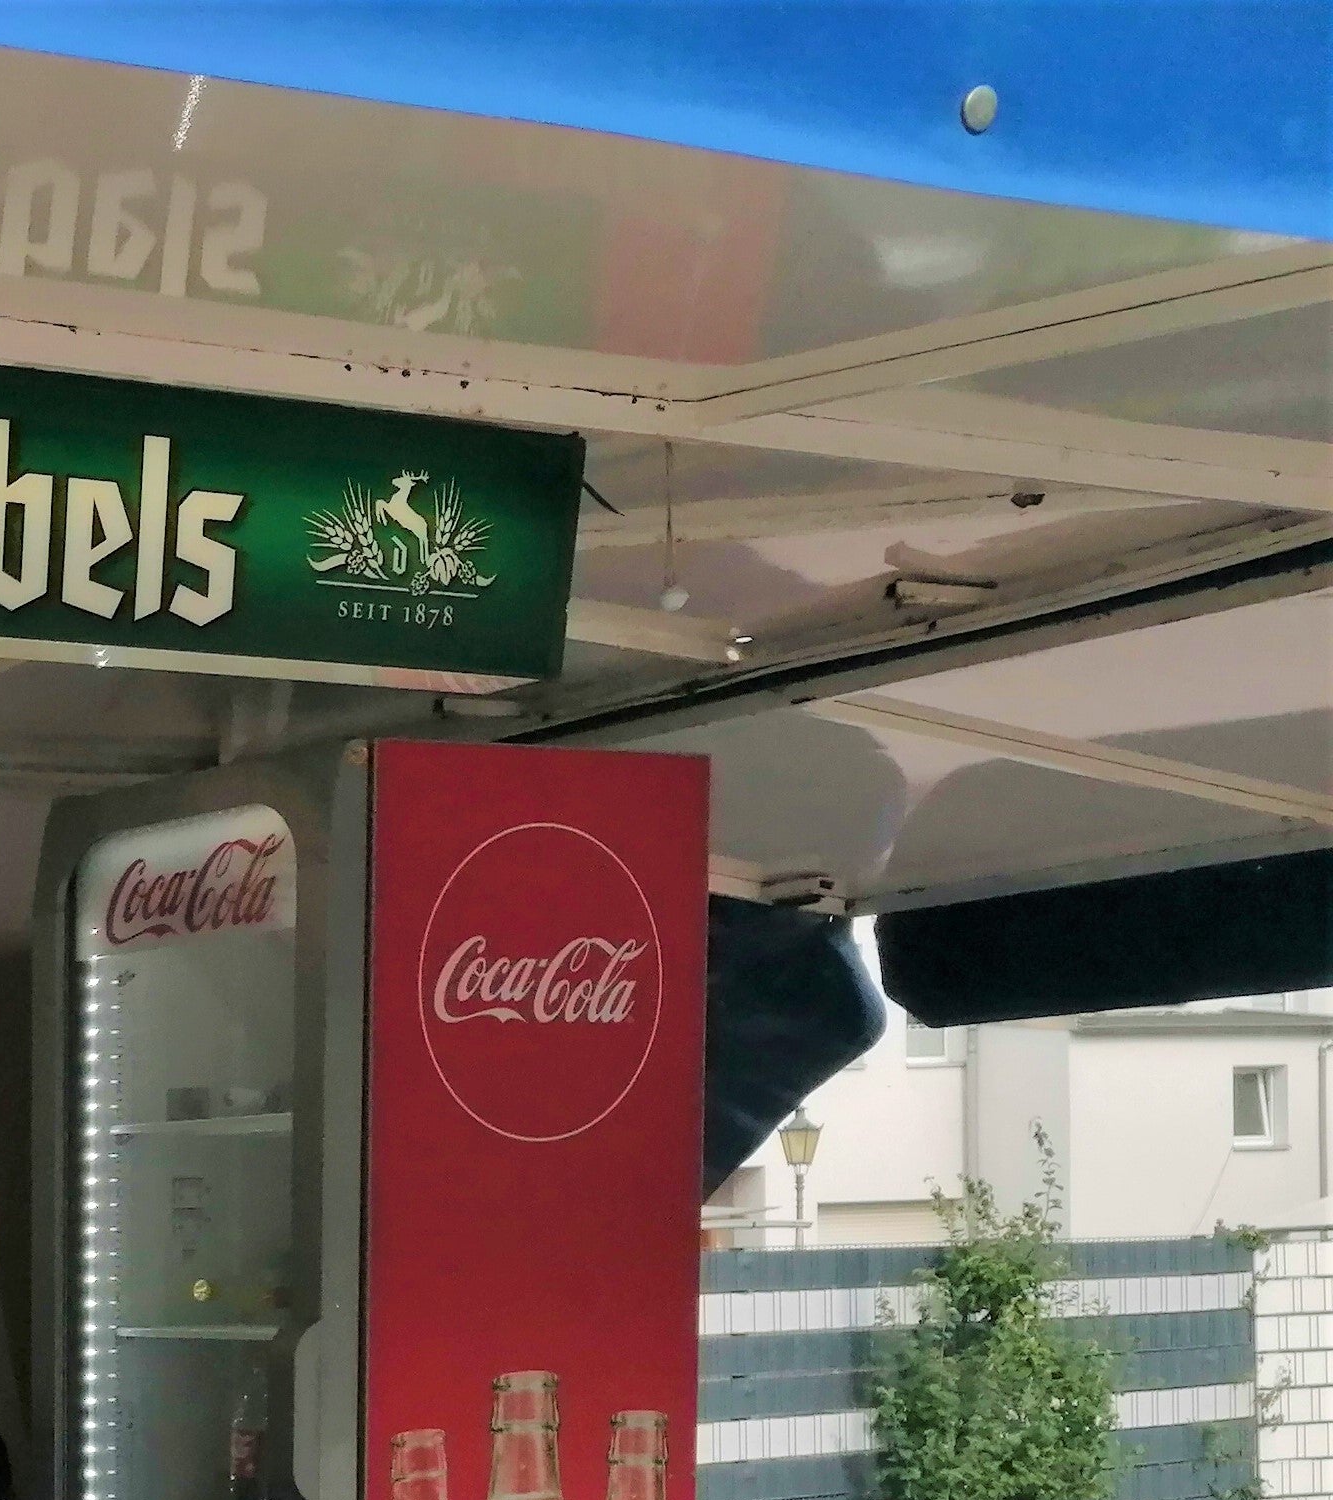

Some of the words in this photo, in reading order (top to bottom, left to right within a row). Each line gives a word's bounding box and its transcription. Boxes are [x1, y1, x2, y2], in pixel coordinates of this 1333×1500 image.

[338, 600, 392, 622] SEIT
[403, 602, 454, 630] 1878
[106, 833, 285, 945] Coca-Cola
[434, 934, 648, 1024] Coca-Cola
